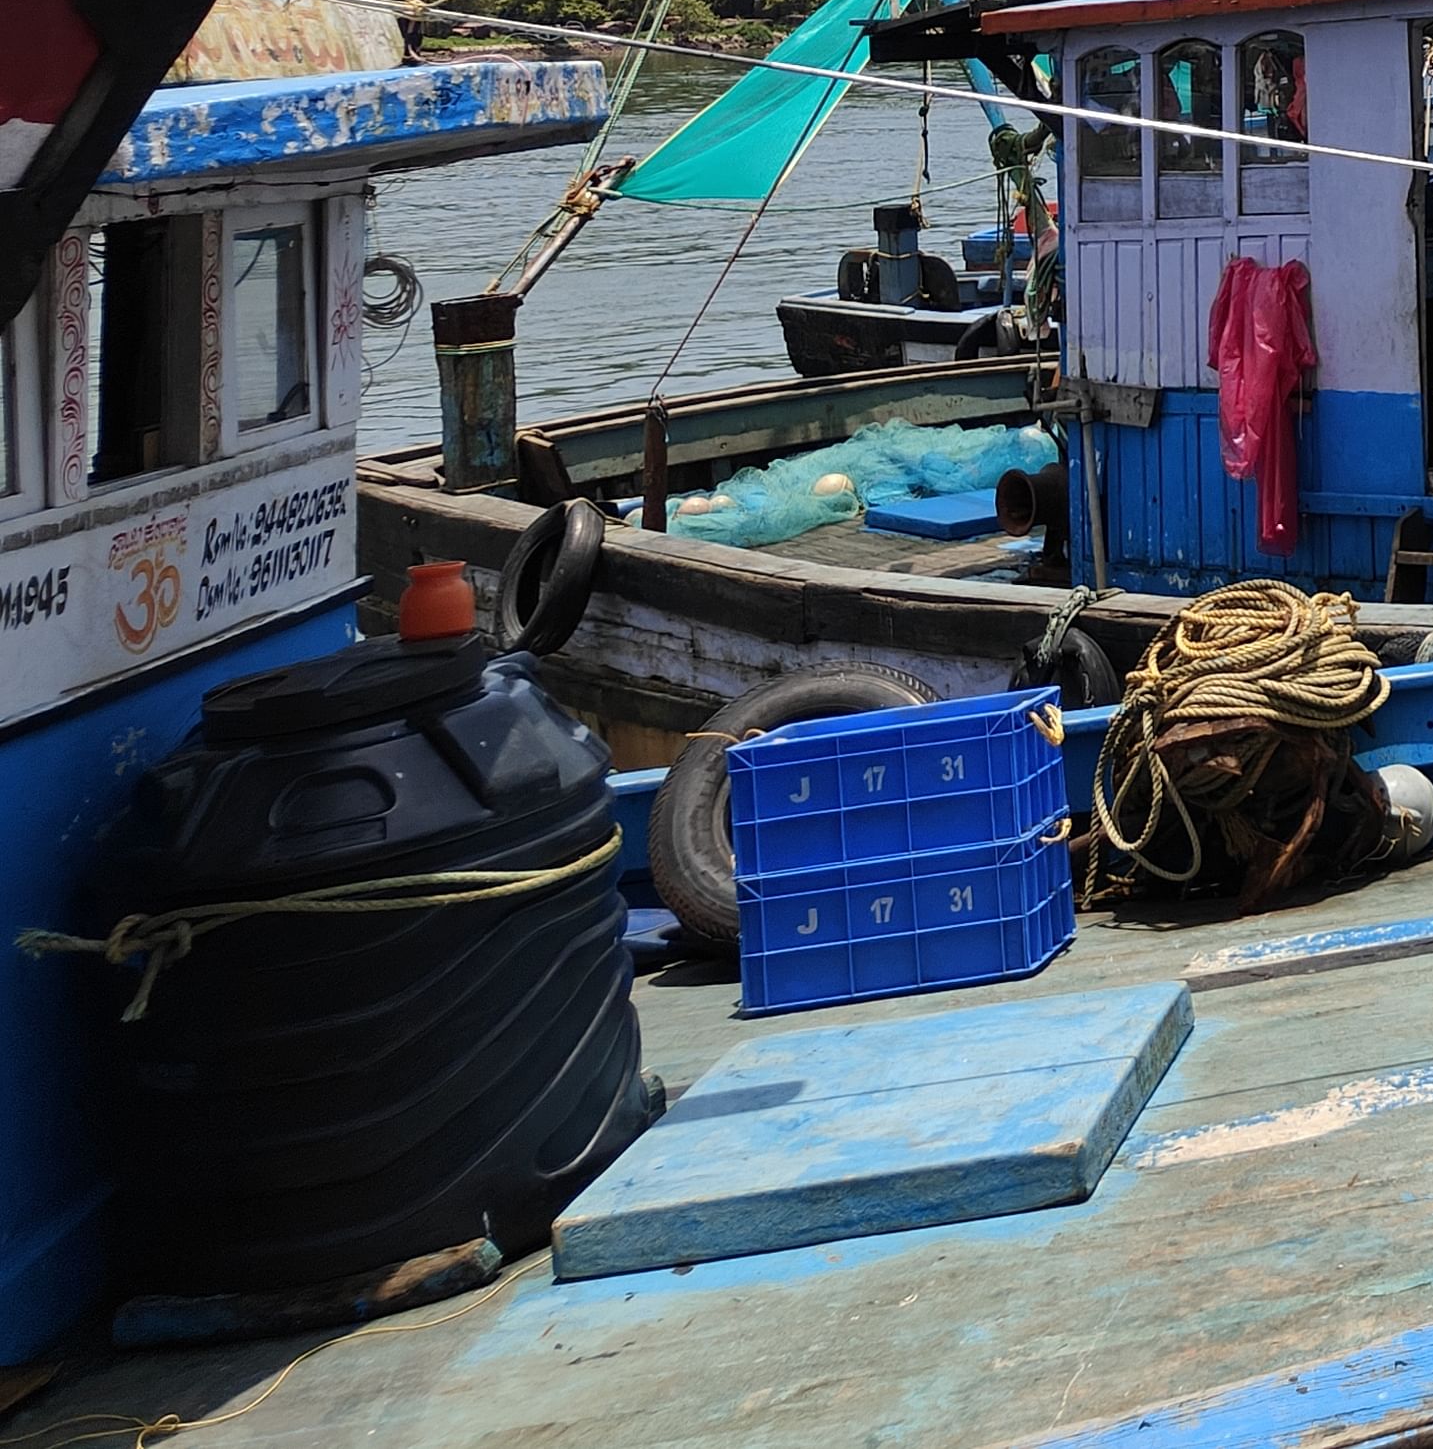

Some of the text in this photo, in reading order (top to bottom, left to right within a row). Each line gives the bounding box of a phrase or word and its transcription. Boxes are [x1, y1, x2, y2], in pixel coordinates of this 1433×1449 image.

[789, 754, 964, 803] J 17 31
[797, 886, 973, 935] J 17 31
